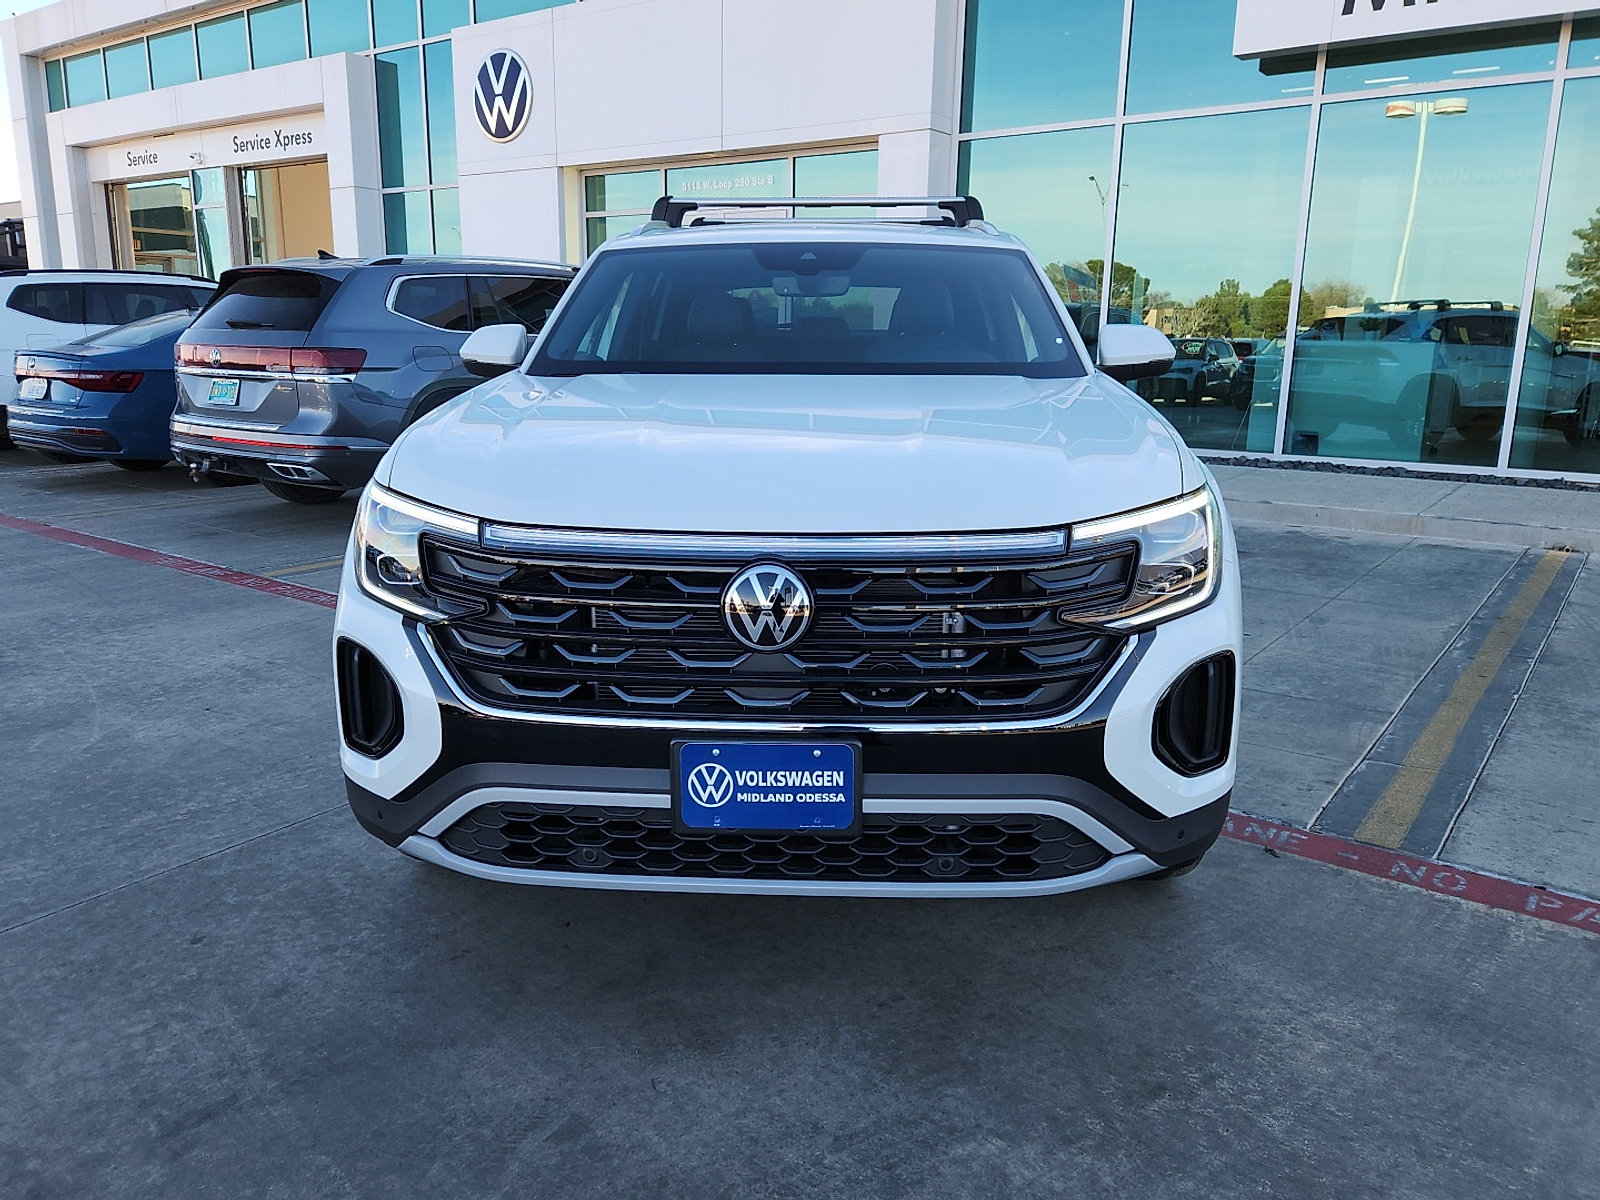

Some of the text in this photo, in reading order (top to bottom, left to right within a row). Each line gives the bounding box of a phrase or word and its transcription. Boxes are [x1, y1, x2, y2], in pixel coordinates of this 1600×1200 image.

[232, 129, 313, 154] Service Xpress
[126, 150, 158, 167] Service
[714, 180, 733, 190] Loop
[752, 176, 765, 185] Ste
[735, 770, 844, 787] VOLKSWAGEN
[736, 792, 846, 803] MIDLAND ODESSA
[1389, 860, 1467, 892] NO
